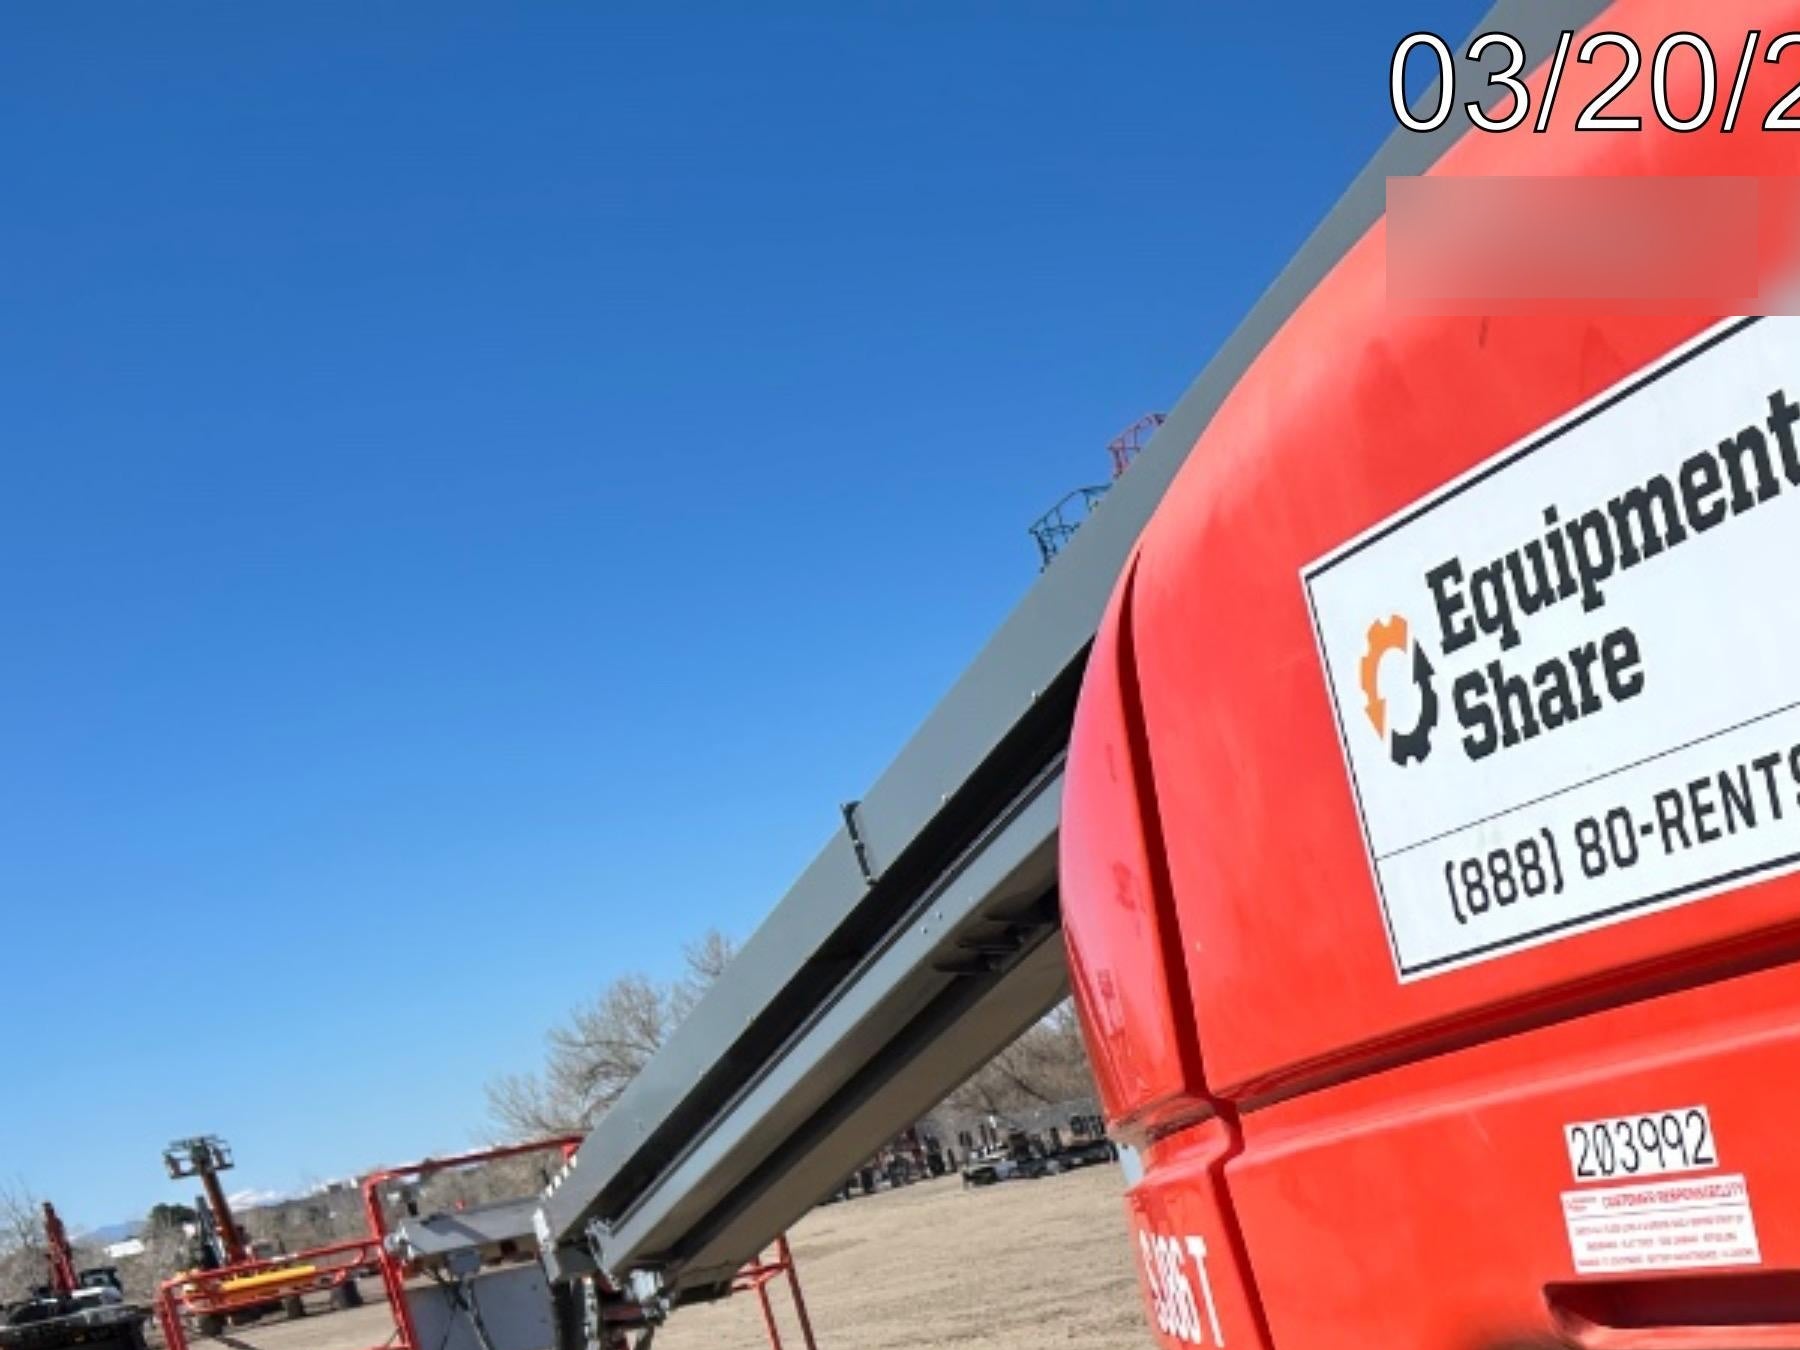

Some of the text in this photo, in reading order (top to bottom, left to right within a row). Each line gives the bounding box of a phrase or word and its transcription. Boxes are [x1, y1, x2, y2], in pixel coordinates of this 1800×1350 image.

[1452, 626, 1645, 762] Share
[1445, 827, 1564, 925] (888)
[1571, 1109, 1713, 1177] 203992
